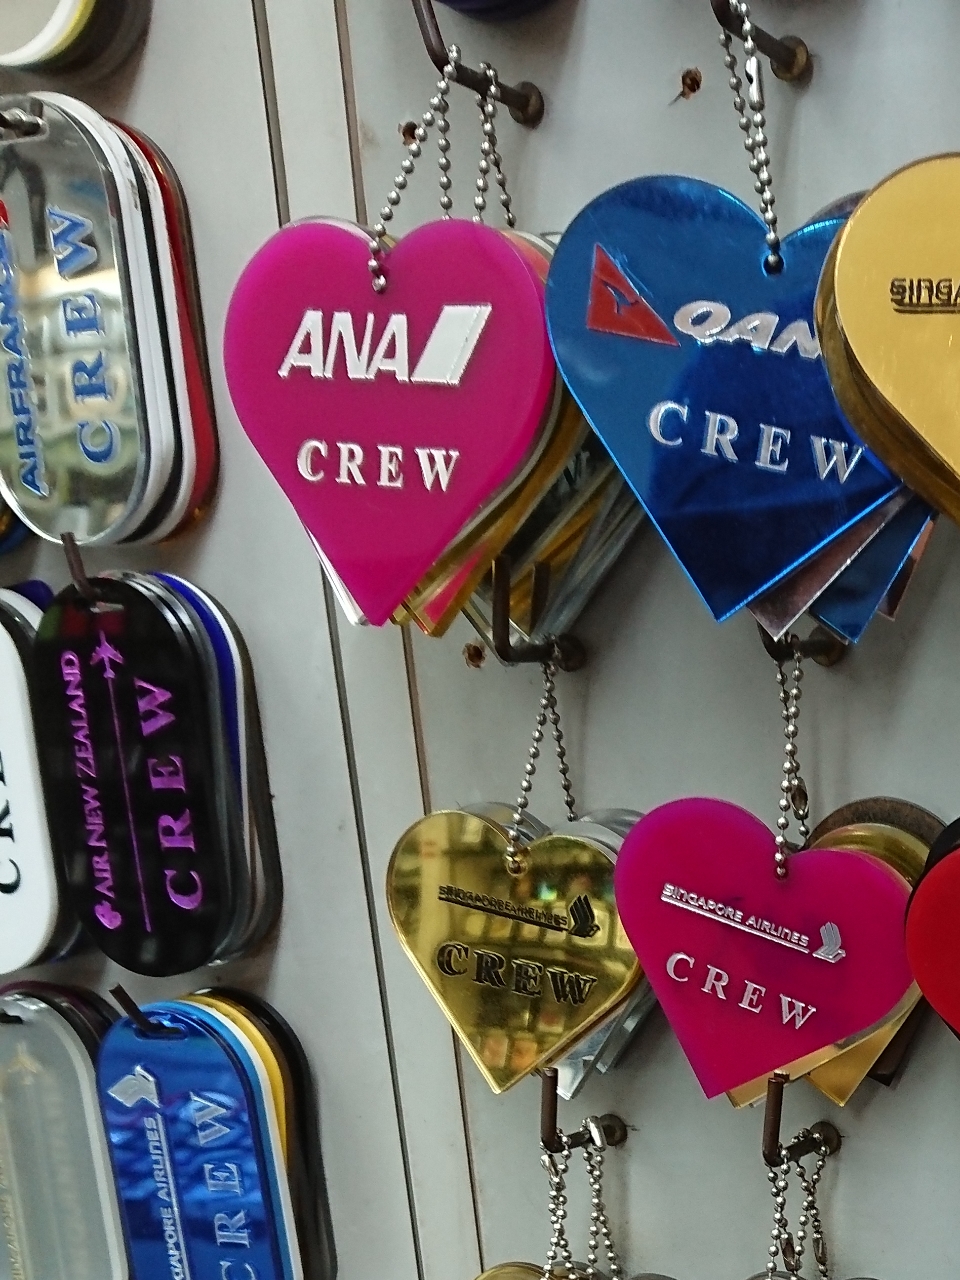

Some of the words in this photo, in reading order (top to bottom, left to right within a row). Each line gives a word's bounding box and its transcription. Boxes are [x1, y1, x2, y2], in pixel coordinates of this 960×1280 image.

[46, 203, 120, 465] CREW
[277, 309, 410, 384] ANA
[295, 438, 460, 493] CREW
[647, 400, 865, 485] CREW
[60, 650, 97, 778] ZEALAND
[81, 782, 108, 848] NEW
[132, 676, 204, 911] CREW
[91, 850, 115, 899] AIR
[662, 882, 744, 922] SINGAPORE
[745, 915, 810, 947] AIRLINES
[436, 941, 598, 1007] CREW
[665, 951, 817, 1031] CREW
[143, 1115, 174, 1202] AIRLINES
